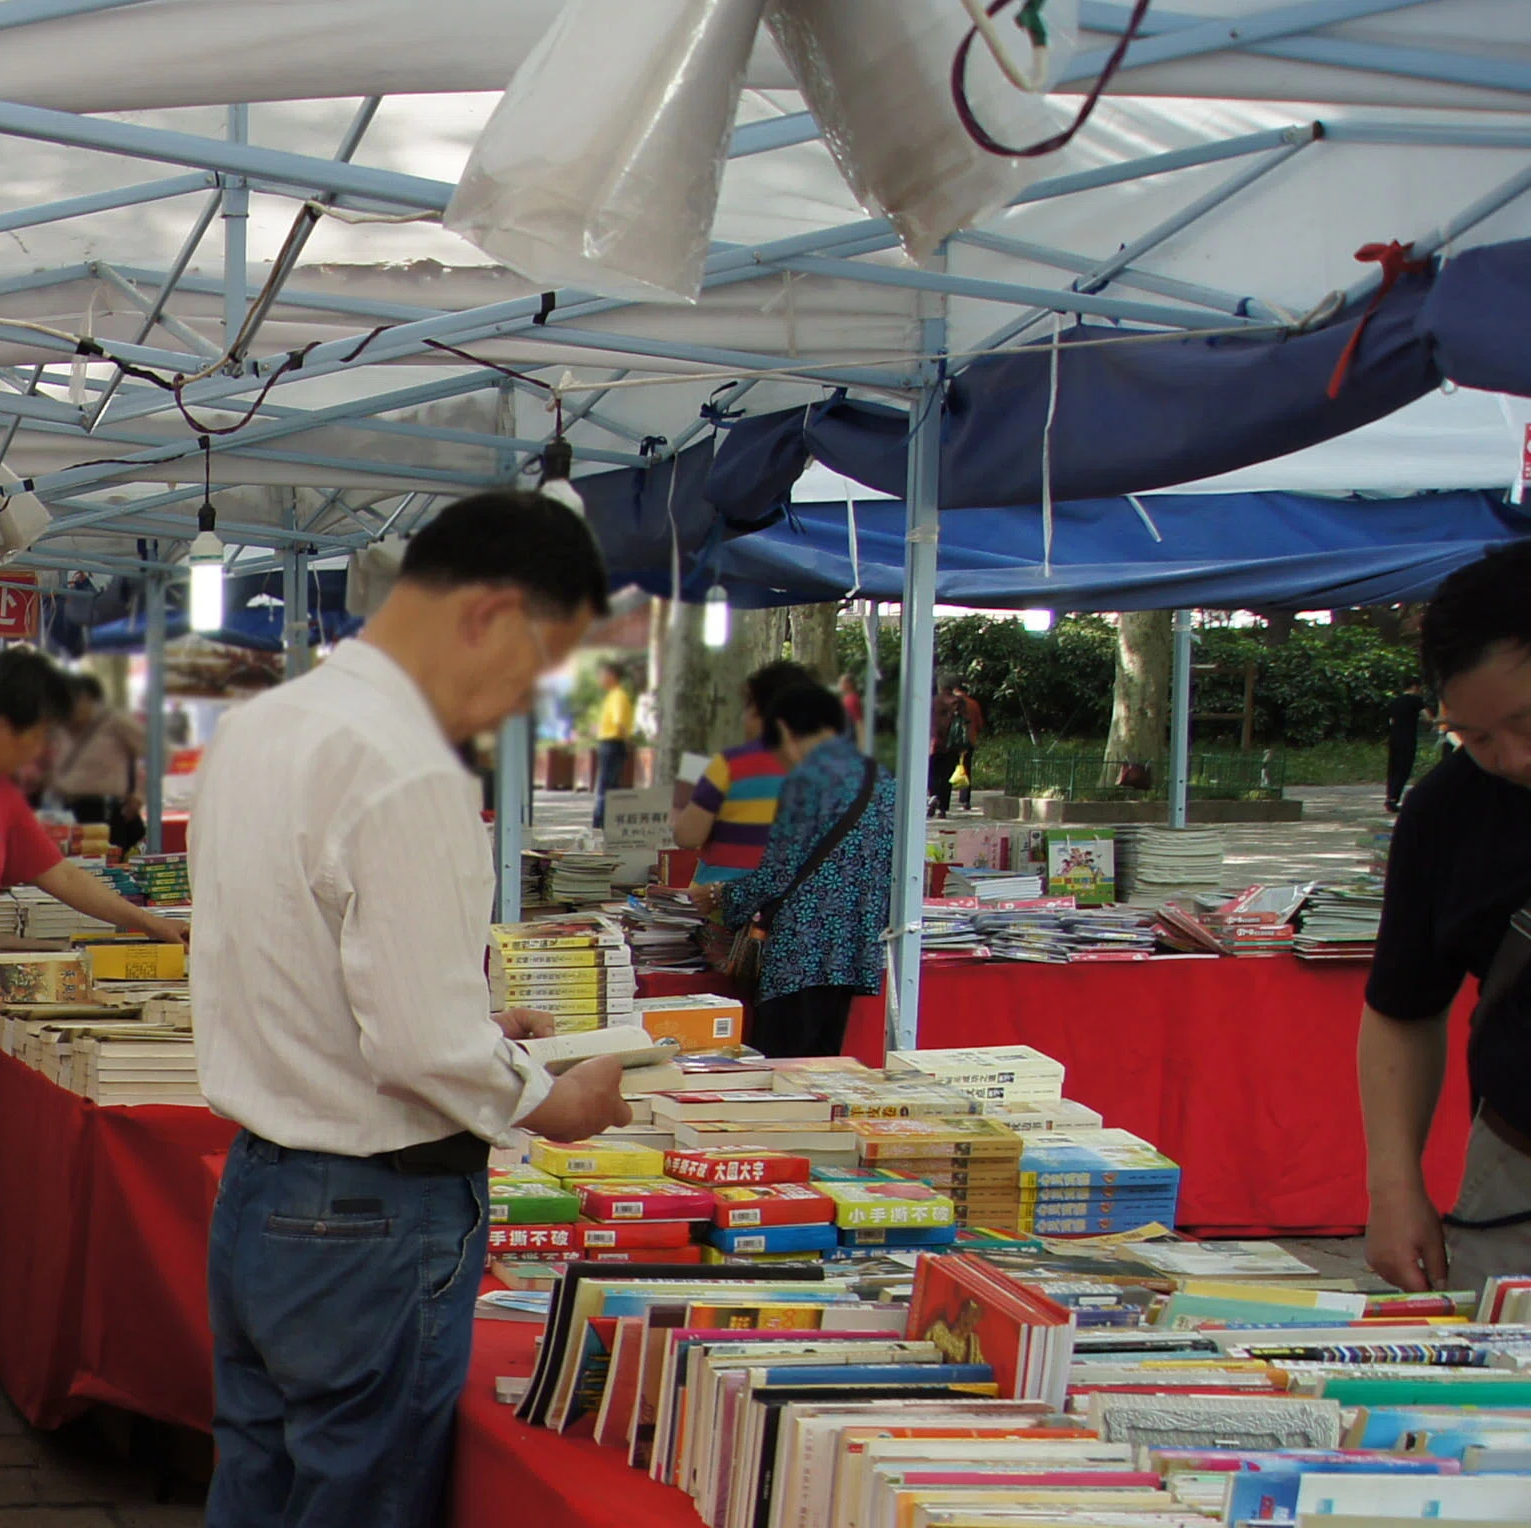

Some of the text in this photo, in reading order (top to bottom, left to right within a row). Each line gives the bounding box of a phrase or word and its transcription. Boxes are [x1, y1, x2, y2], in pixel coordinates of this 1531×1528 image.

[846, 1200, 952, 1225] 小手撕不破
